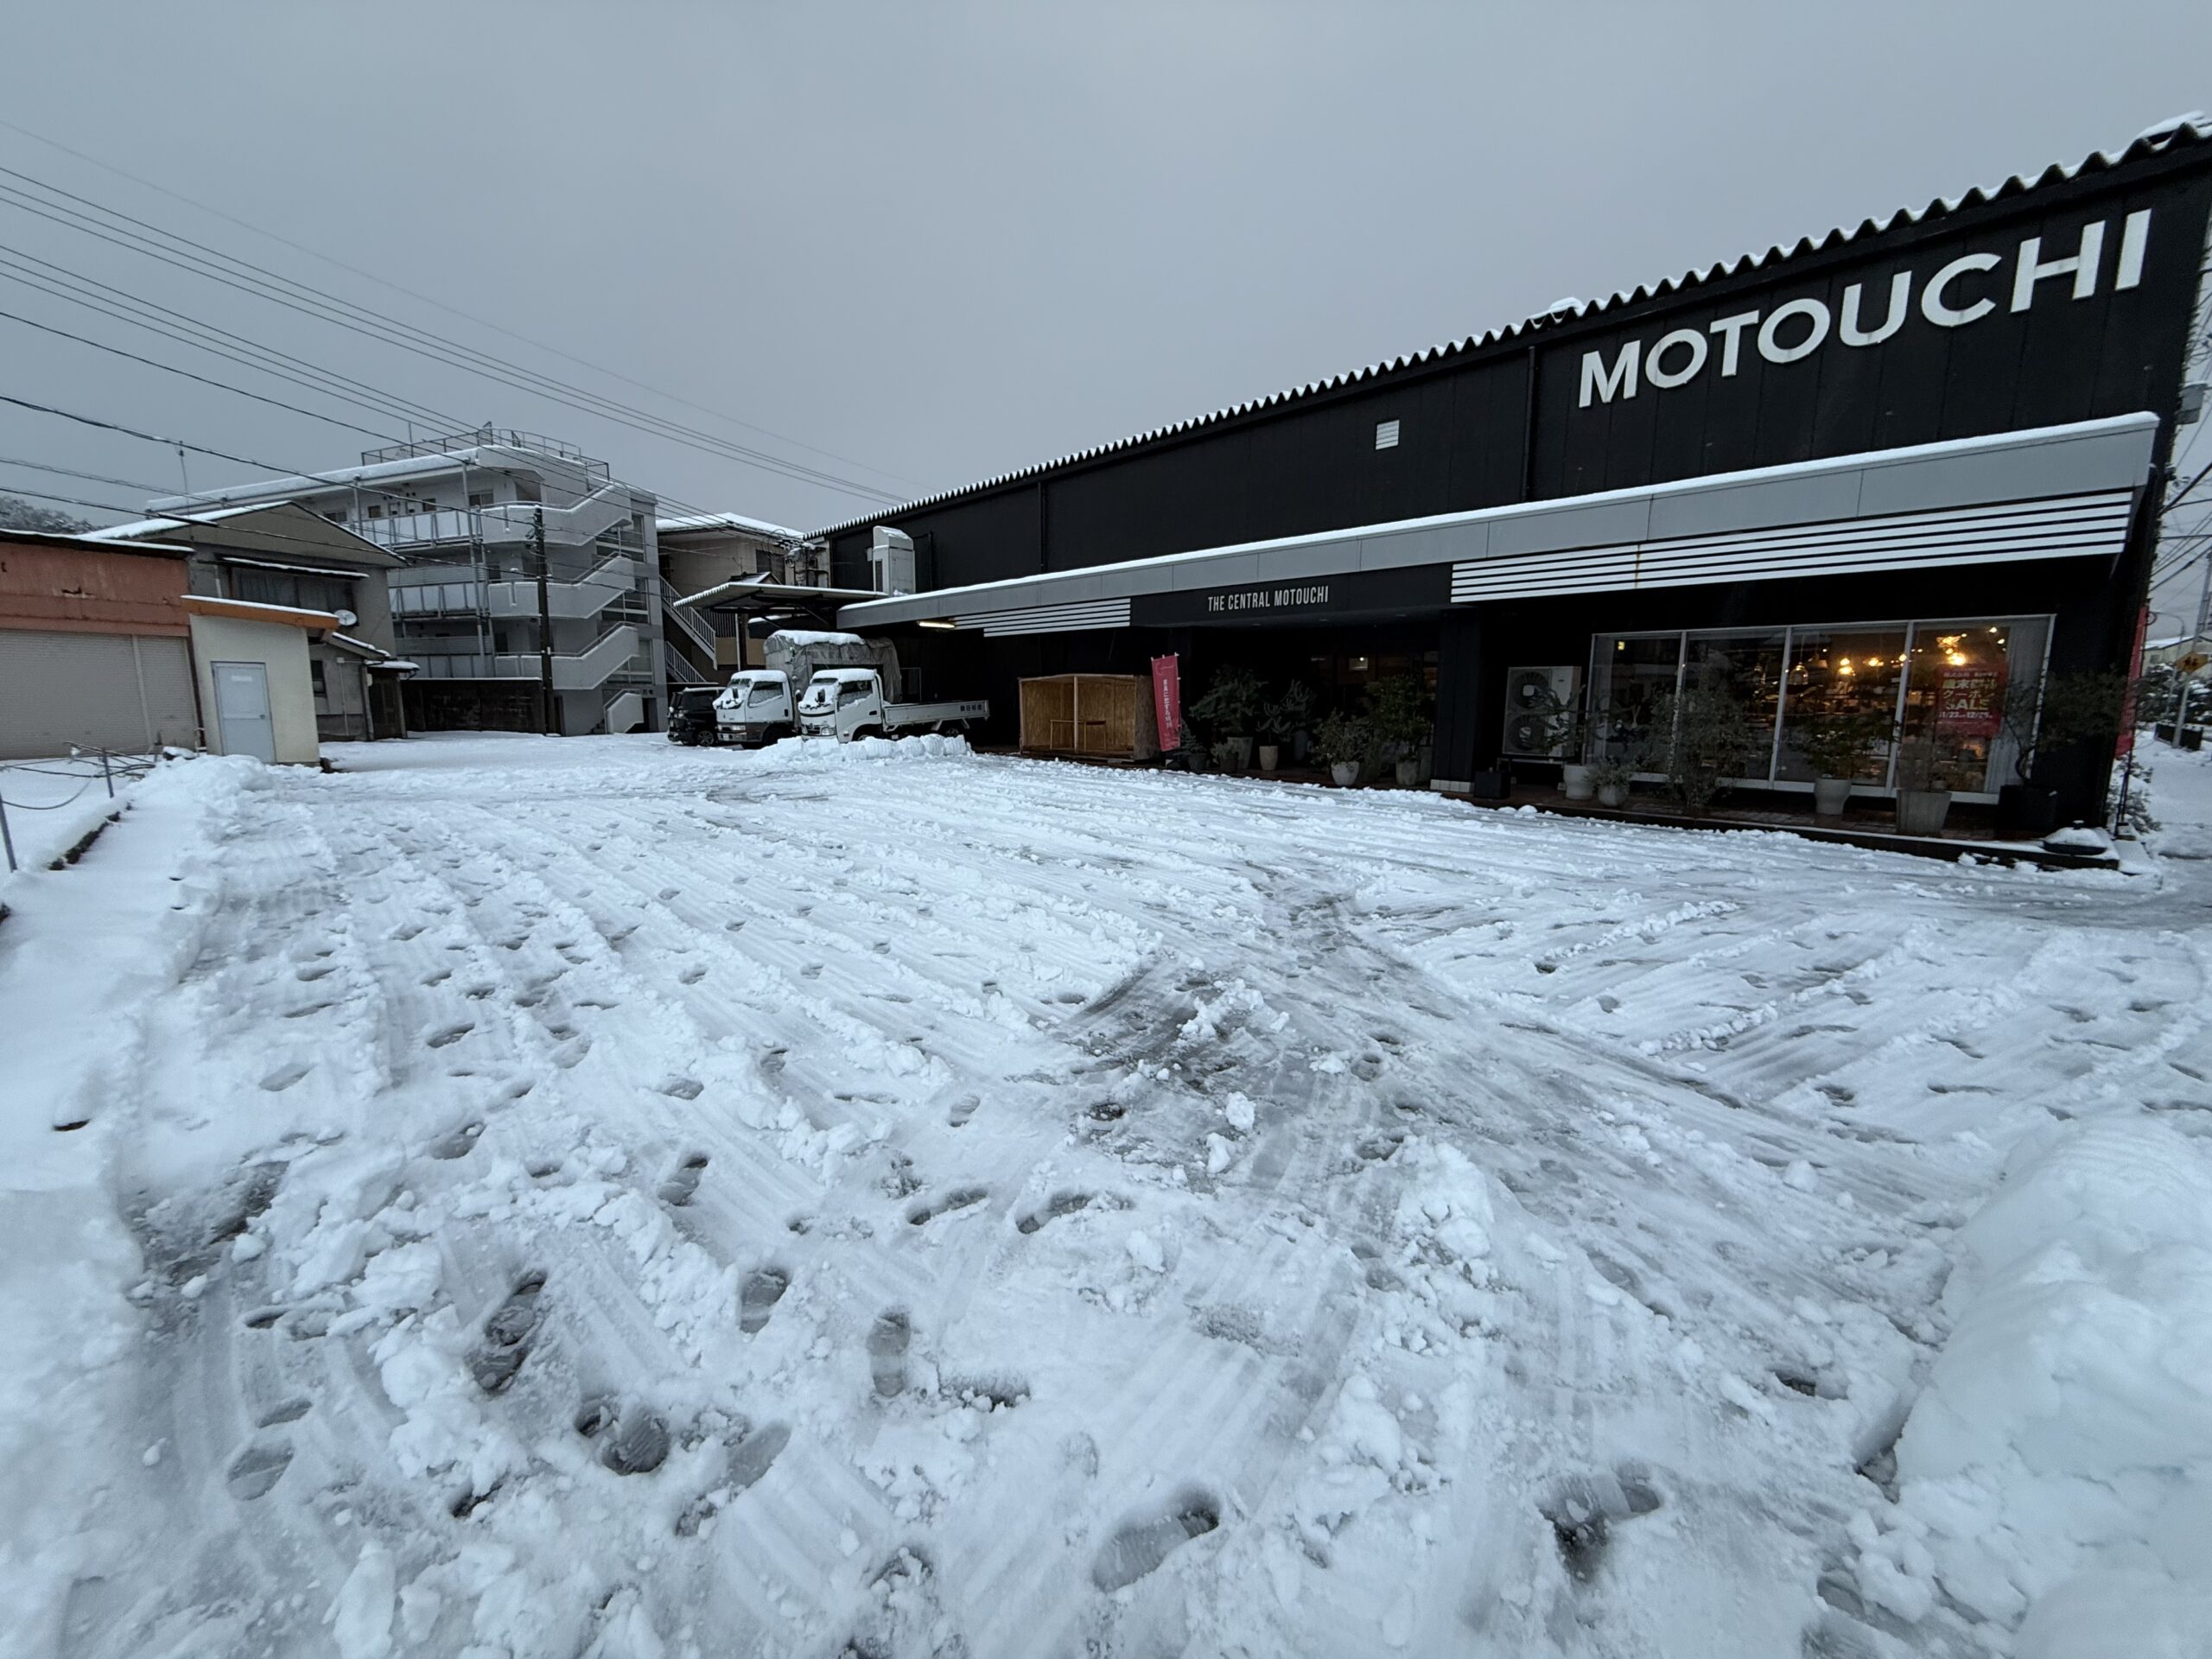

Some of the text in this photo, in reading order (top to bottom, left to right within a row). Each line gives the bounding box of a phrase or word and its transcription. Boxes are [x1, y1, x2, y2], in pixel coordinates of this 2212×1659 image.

[1579, 208, 2152, 409] MOTOUCHI
[1208, 585, 1329, 612] THE CENTRAL MOTOUCHI
[1945, 698, 1990, 710] SALE
